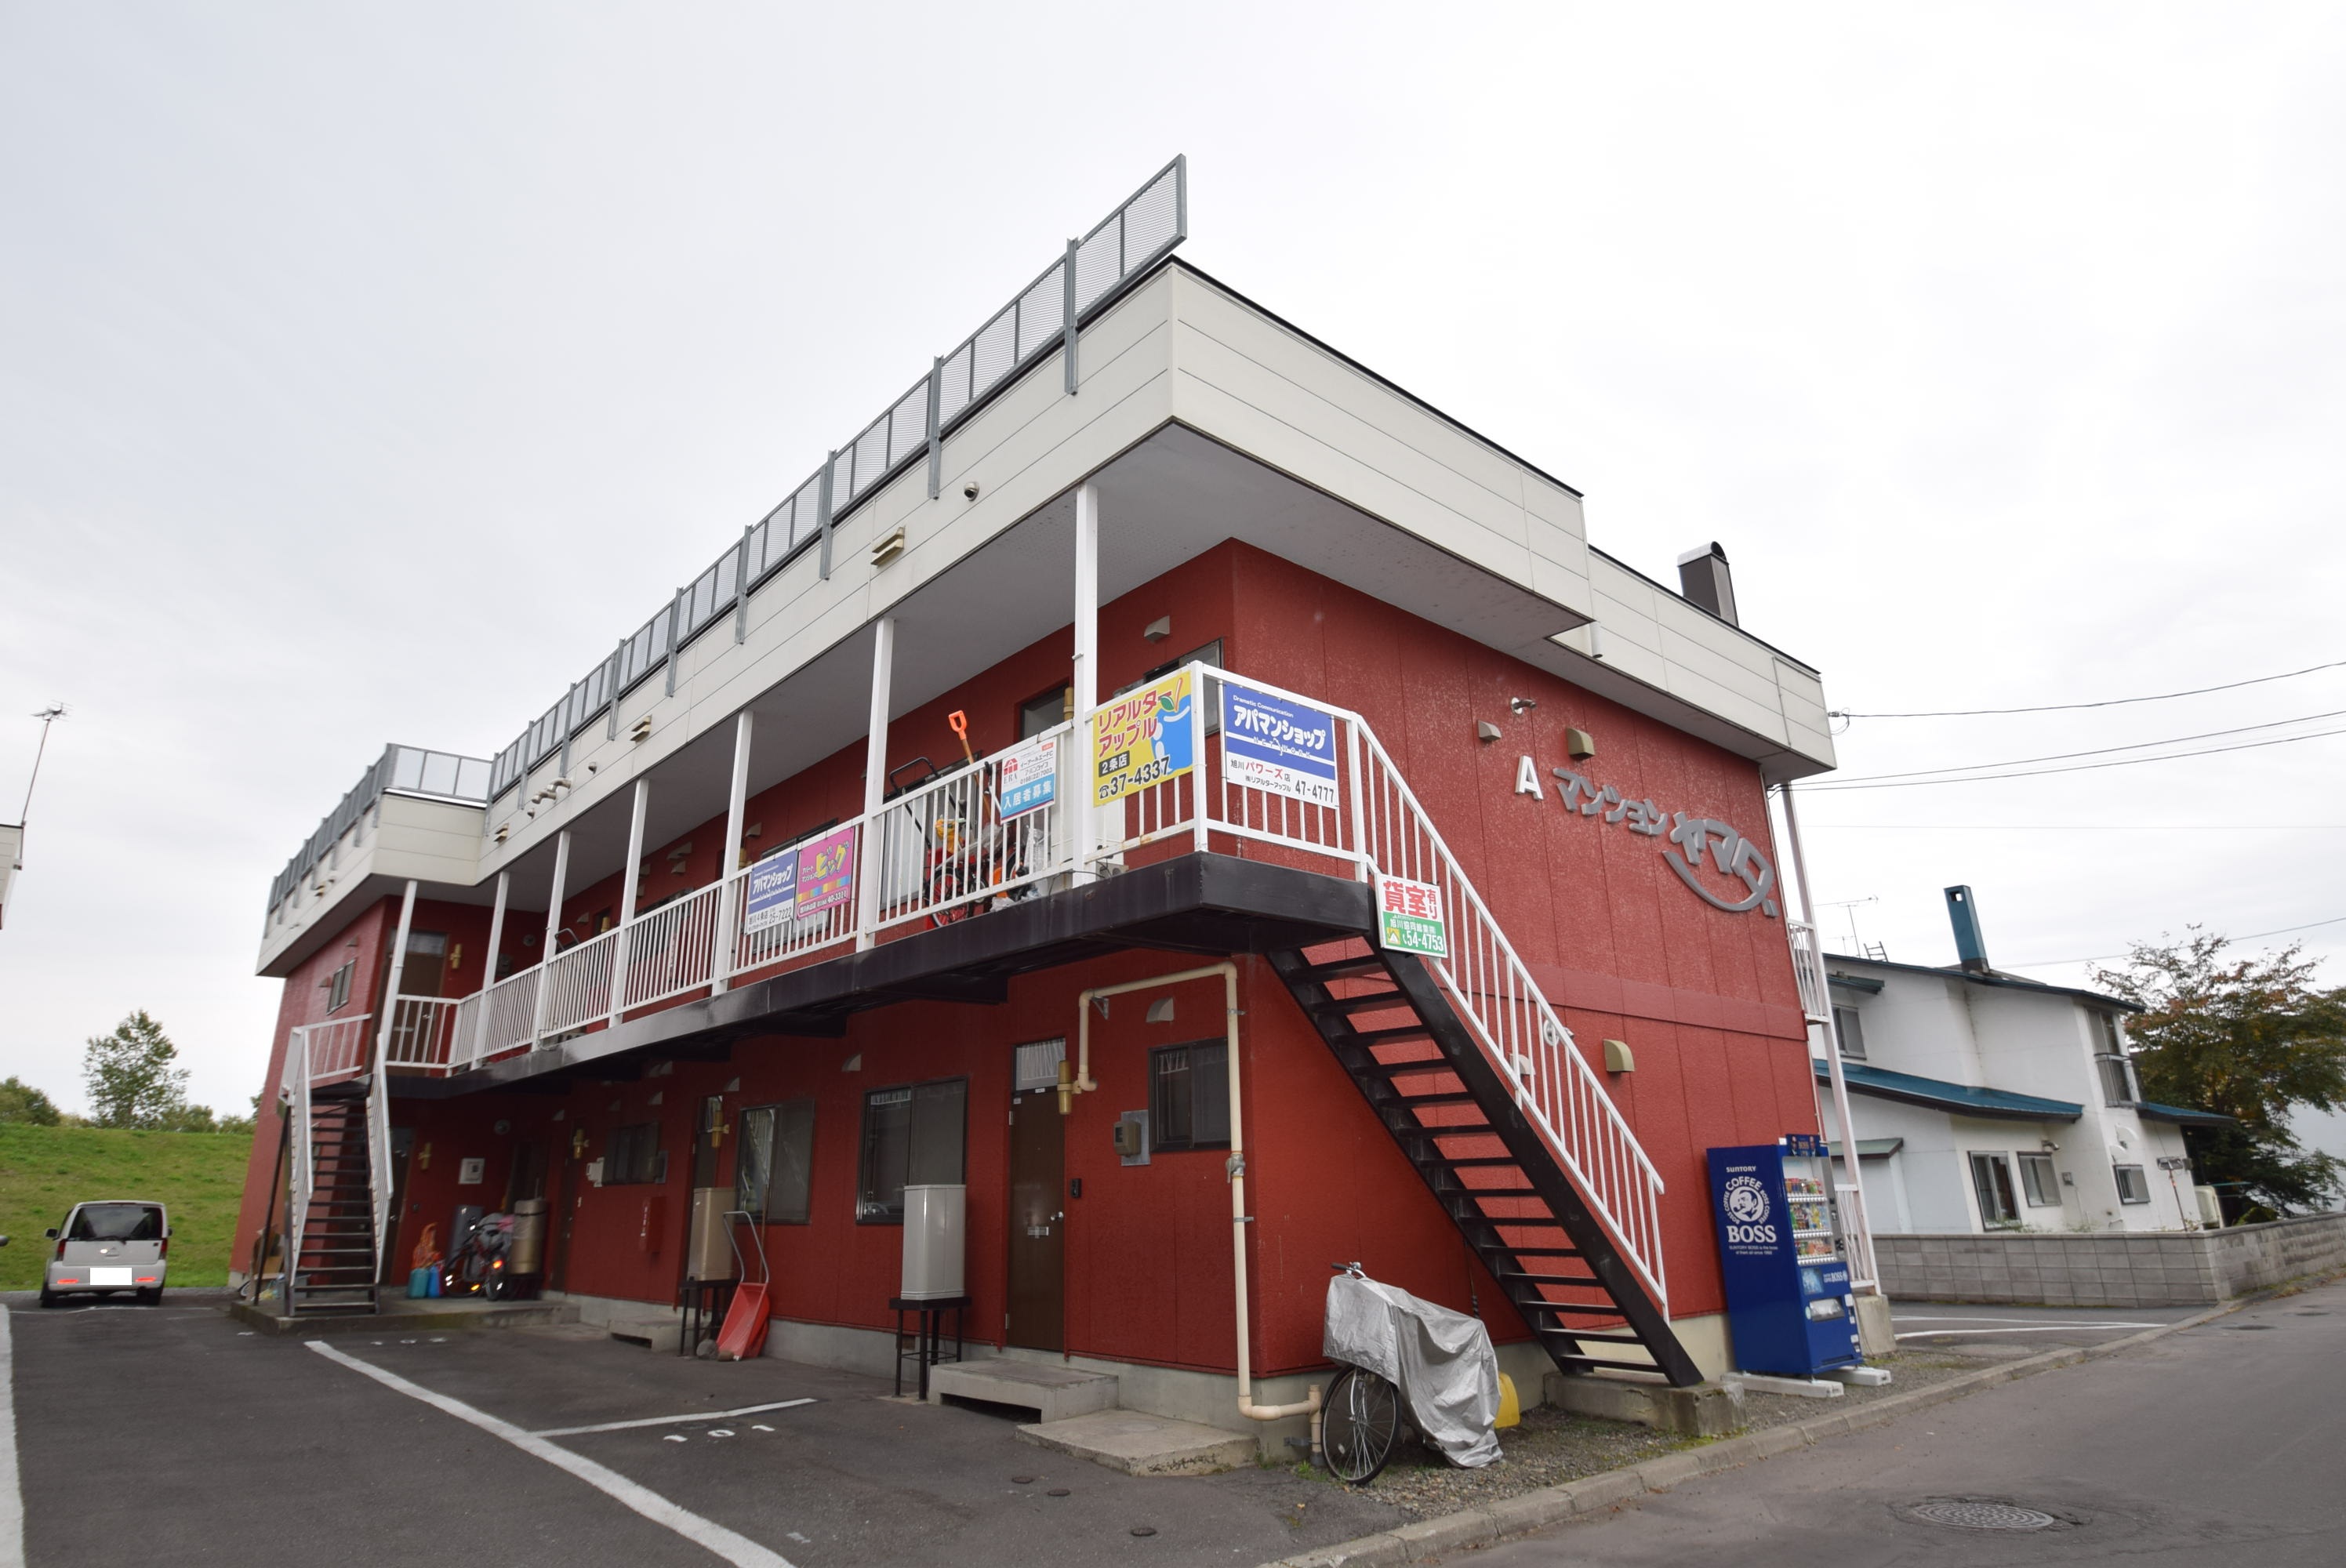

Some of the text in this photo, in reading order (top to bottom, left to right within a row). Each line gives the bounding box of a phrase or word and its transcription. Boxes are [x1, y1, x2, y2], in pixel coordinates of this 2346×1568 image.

[1099, 690, 1172, 735] リアルター
[1233, 695, 1294, 718] Dramatic Communication
[1099, 717, 1158, 758] アップル
[1233, 705, 1326, 750] アパマンショップ
[1102, 753, 1128, 775] 2条店
[1110, 756, 1169, 795] 37-4337
[1004, 773, 1018, 785] ERA
[1295, 779, 1334, 803] 47-4777
[1004, 780, 1051, 810] 入居者募集
[1515, 755, 1544, 800] A
[1552, 768, 1668, 837] マンション
[815, 840, 849, 880] ビッグ
[753, 863, 794, 895] アパマンショップ
[769, 908, 792, 925] 25-7222
[1406, 931, 1444, 951] 54-4753
[1725, 1176, 1763, 1191] COFFEE
[1726, 1225, 1777, 1243] BOSS
[663, 1425, 775, 1443] 101
